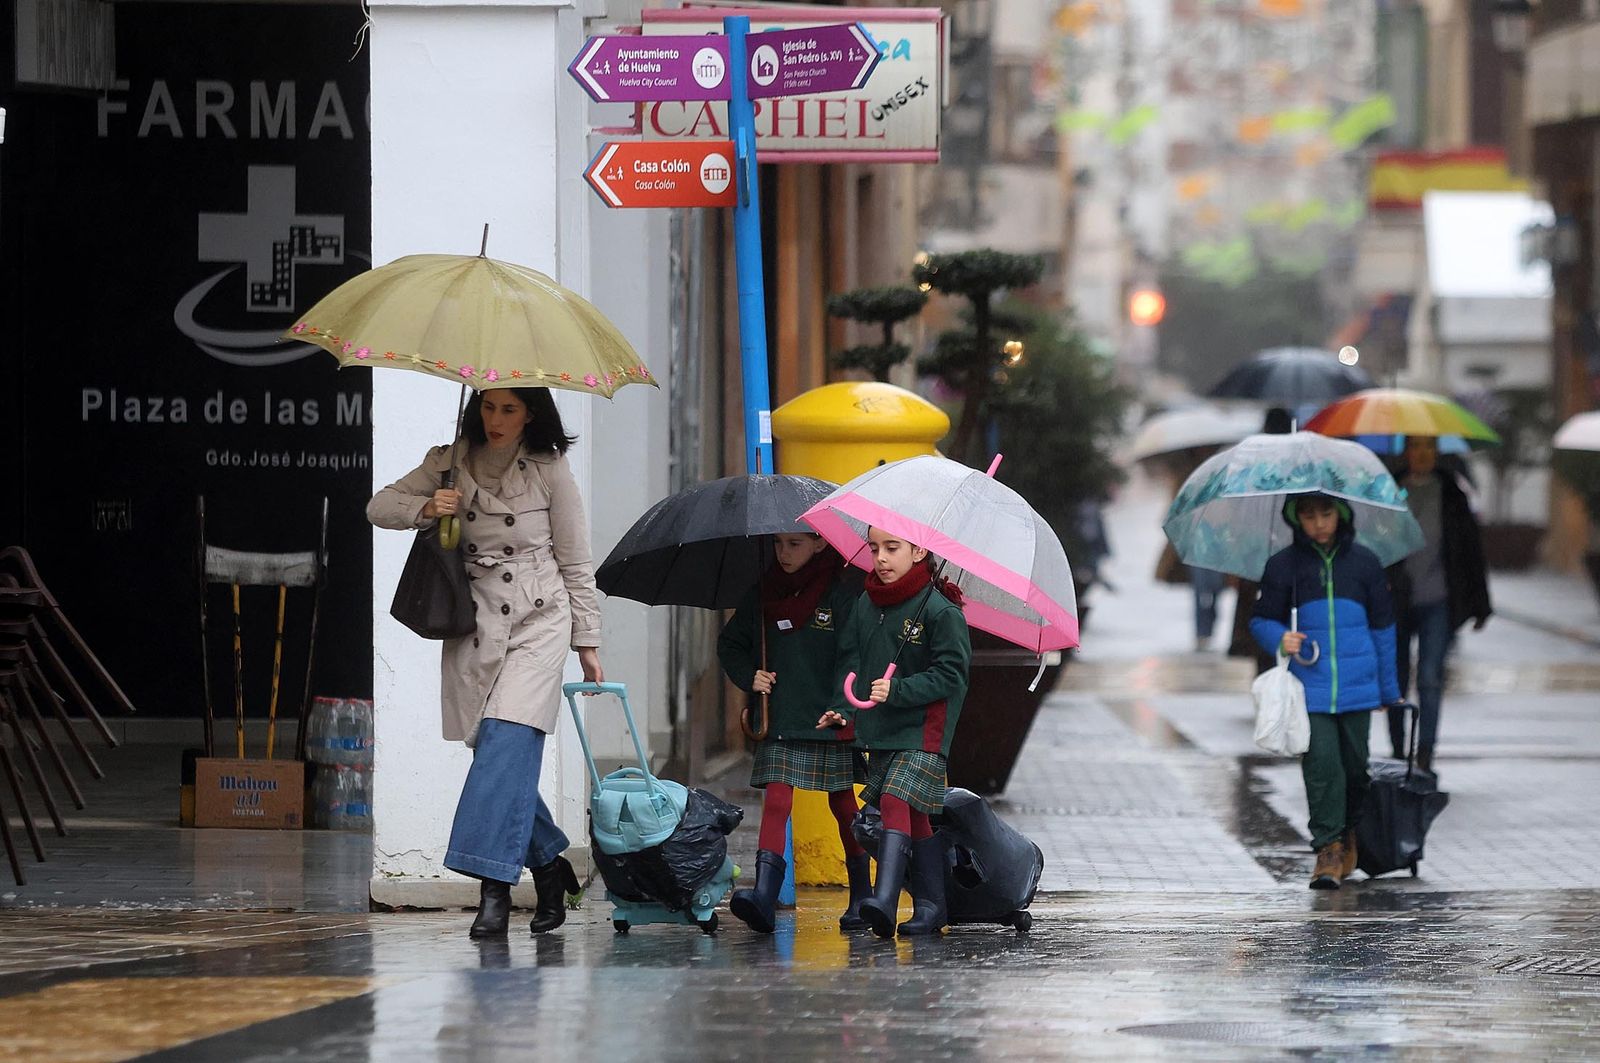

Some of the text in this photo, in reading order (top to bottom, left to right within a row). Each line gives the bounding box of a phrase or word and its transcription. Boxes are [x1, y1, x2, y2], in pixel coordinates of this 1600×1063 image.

[782, 38, 817, 54] Iglesia de
[617, 48, 680, 61] Ayuntamiento
[783, 49, 843, 66] San Pedro (s. XV)
[618, 61, 661, 73] de Huelva
[783, 68, 827, 80] San Pedro Church
[619, 78, 678, 89] Huelva City Council
[871, 75, 929, 121] UNISEX
[97, 79, 371, 139] FARMA
[650, 97, 886, 139] CAHEL
[633, 158, 691, 173] Casa Colón
[634, 178, 676, 190] Casa Colón
[82, 388, 373, 426] Plaza de las M
[296, 451, 368, 471] Joaquín
[219, 775, 278, 791] Mahou
